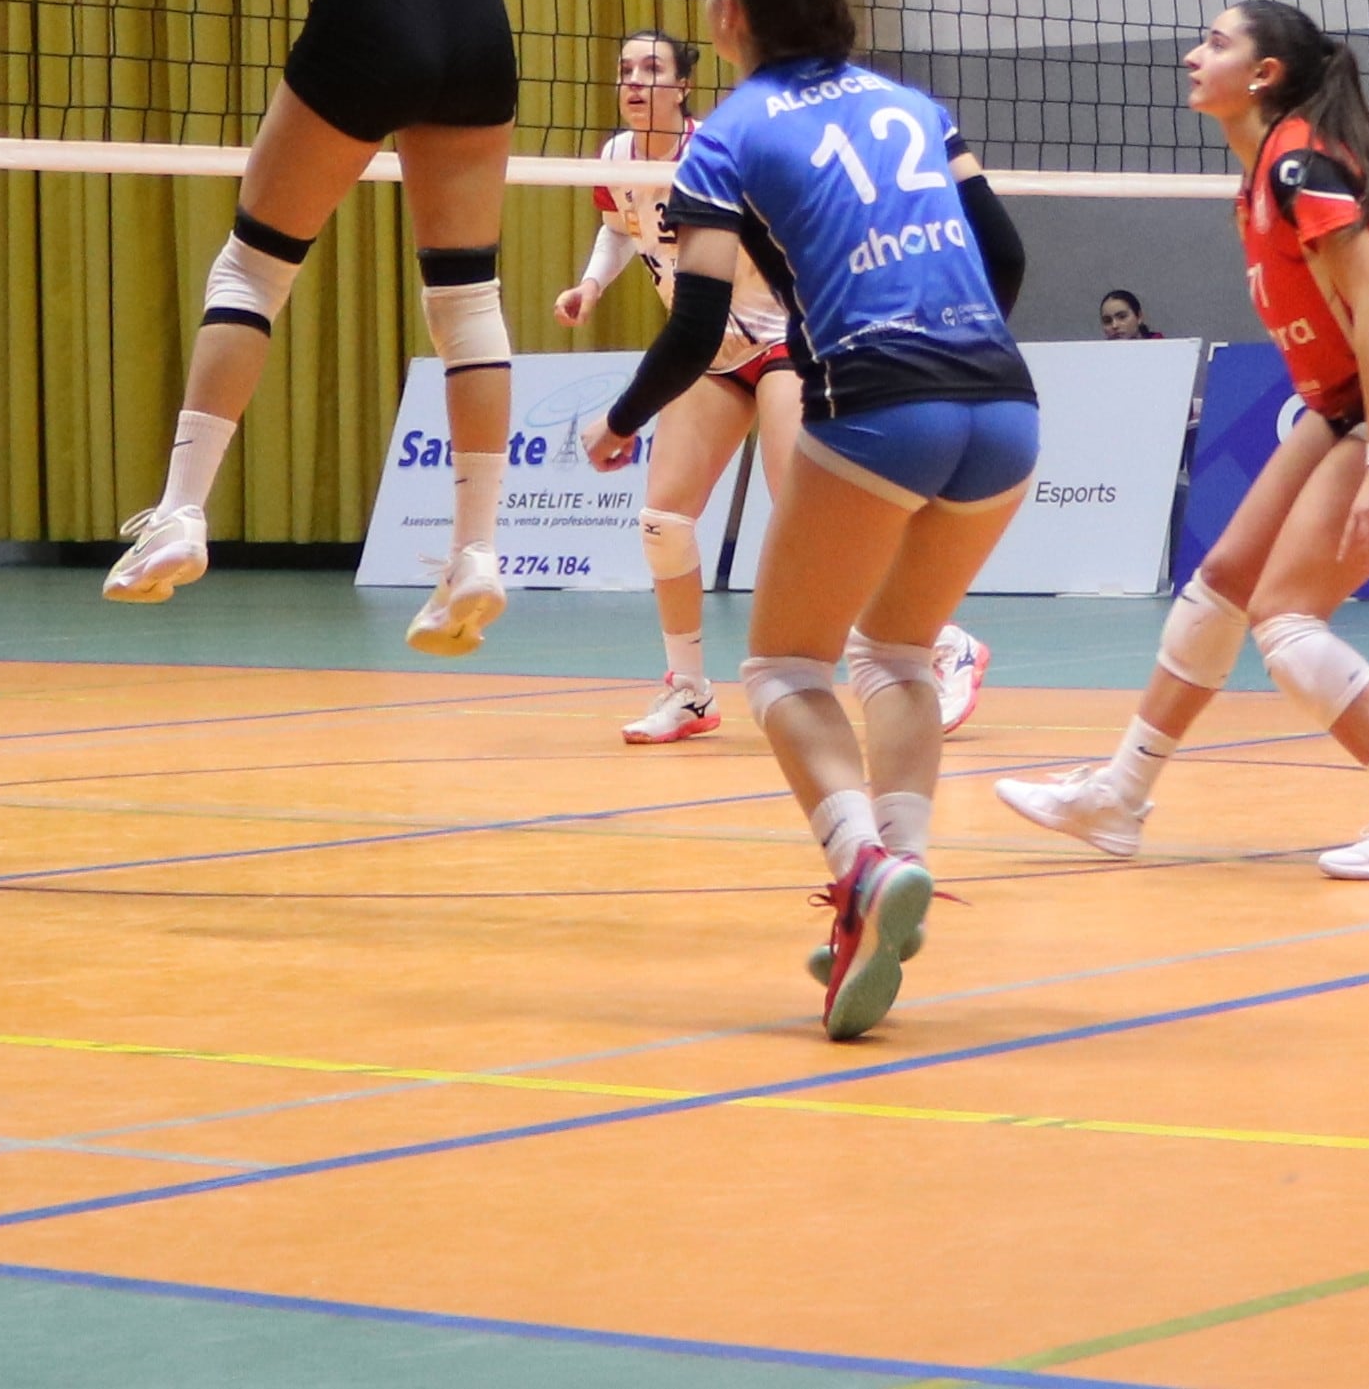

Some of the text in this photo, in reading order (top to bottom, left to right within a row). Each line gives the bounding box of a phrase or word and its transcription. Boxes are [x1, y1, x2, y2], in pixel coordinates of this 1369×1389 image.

[811, 107, 946, 204] 12
[849, 219, 966, 275] ahora
[507, 489, 583, 509] SATÉLITE
[597, 493, 632, 509] WIFI
[1035, 481, 1117, 508] Esports
[513, 556, 549, 575] 274
[557, 556, 591, 575] 184
